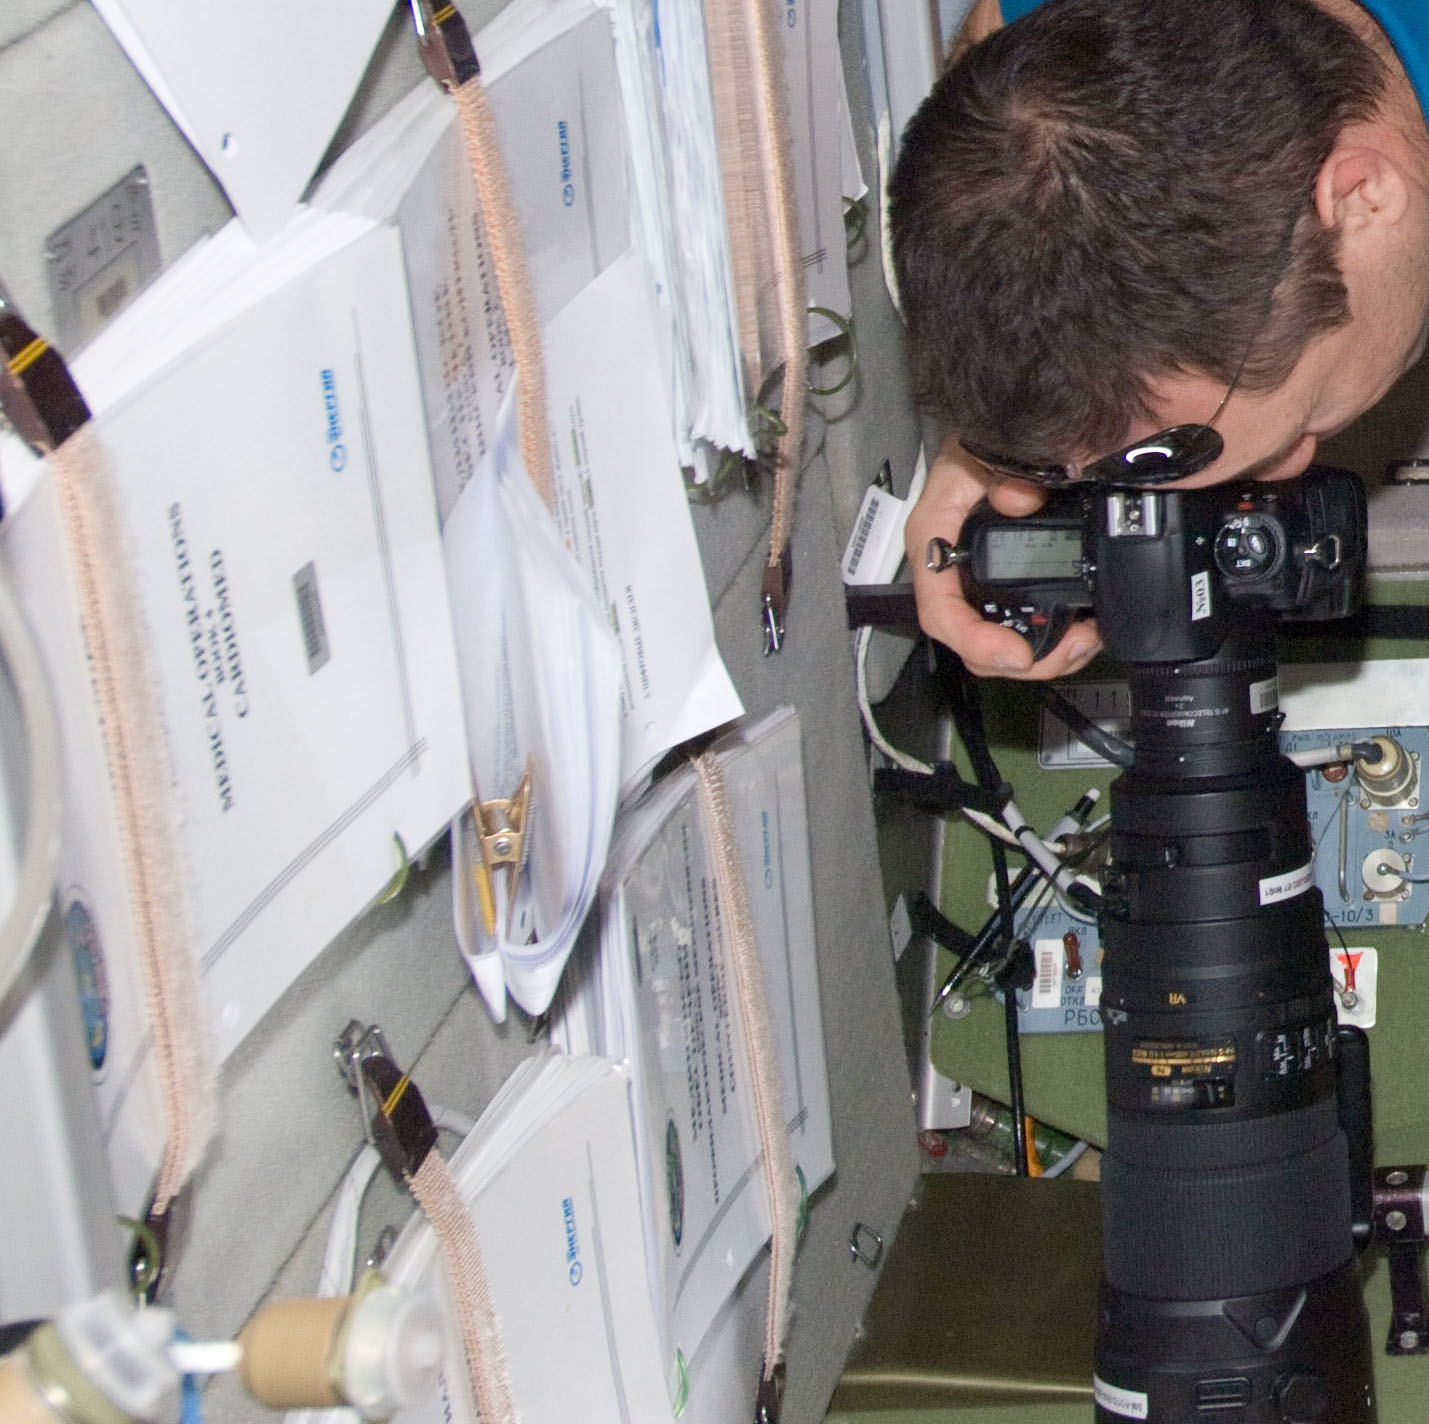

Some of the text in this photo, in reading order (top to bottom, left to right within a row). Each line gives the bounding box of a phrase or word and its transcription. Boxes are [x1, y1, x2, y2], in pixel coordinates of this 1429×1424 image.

[210, 549, 250, 719] CARDIOMED
[168, 502, 234, 814] MEDICAL OPERATIONS
[208, 628, 227, 684] BOOK
[1167, 719, 1196, 728] Nikon
[1065, 985, 1083, 994] OFF
[1060, 995, 1086, 1006] ОТКЛ
[1168, 992, 1187, 1005] VR
